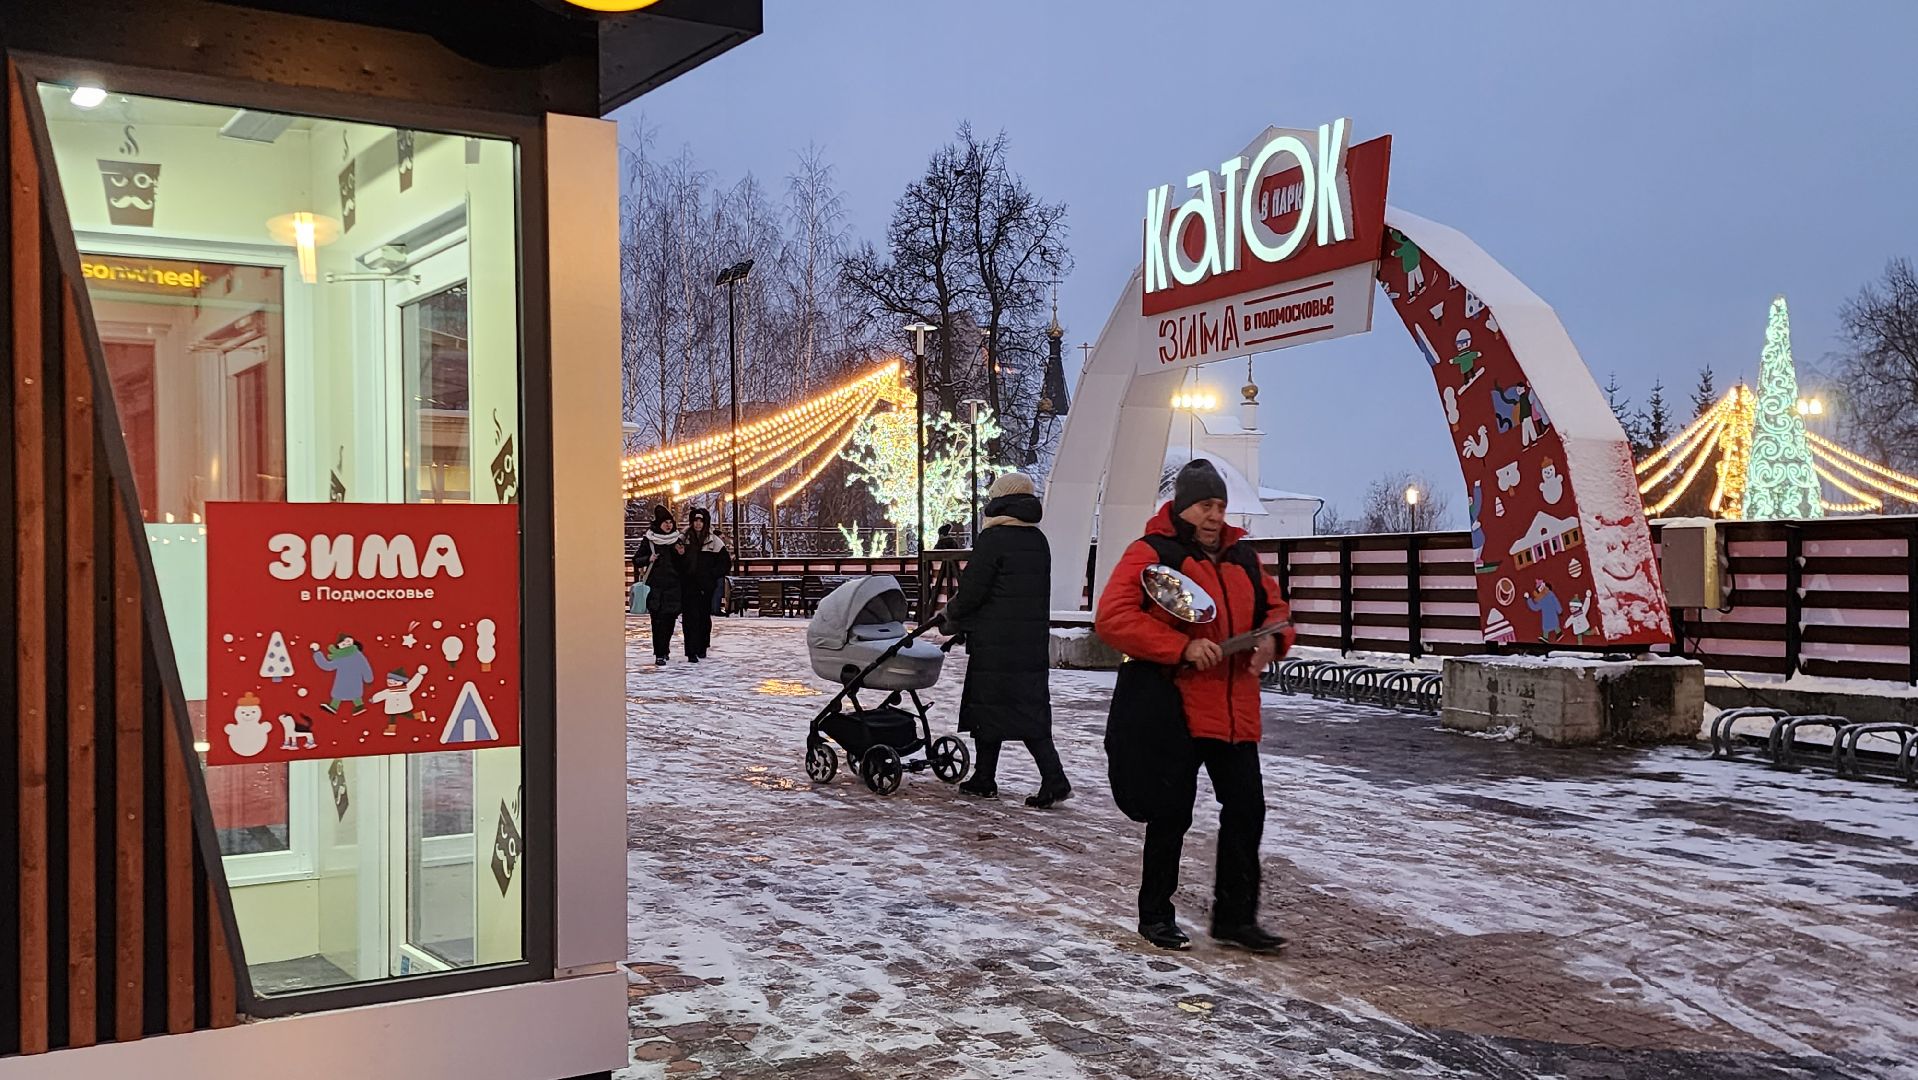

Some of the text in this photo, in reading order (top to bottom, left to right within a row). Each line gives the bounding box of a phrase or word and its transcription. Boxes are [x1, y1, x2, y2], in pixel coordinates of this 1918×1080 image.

[1158, 304, 1239, 364] ЗИМА
[1244, 315, 1252, 331] в
[268, 533, 464, 580] ЗИМА
[300, 586, 435, 602] в Подмосковье
